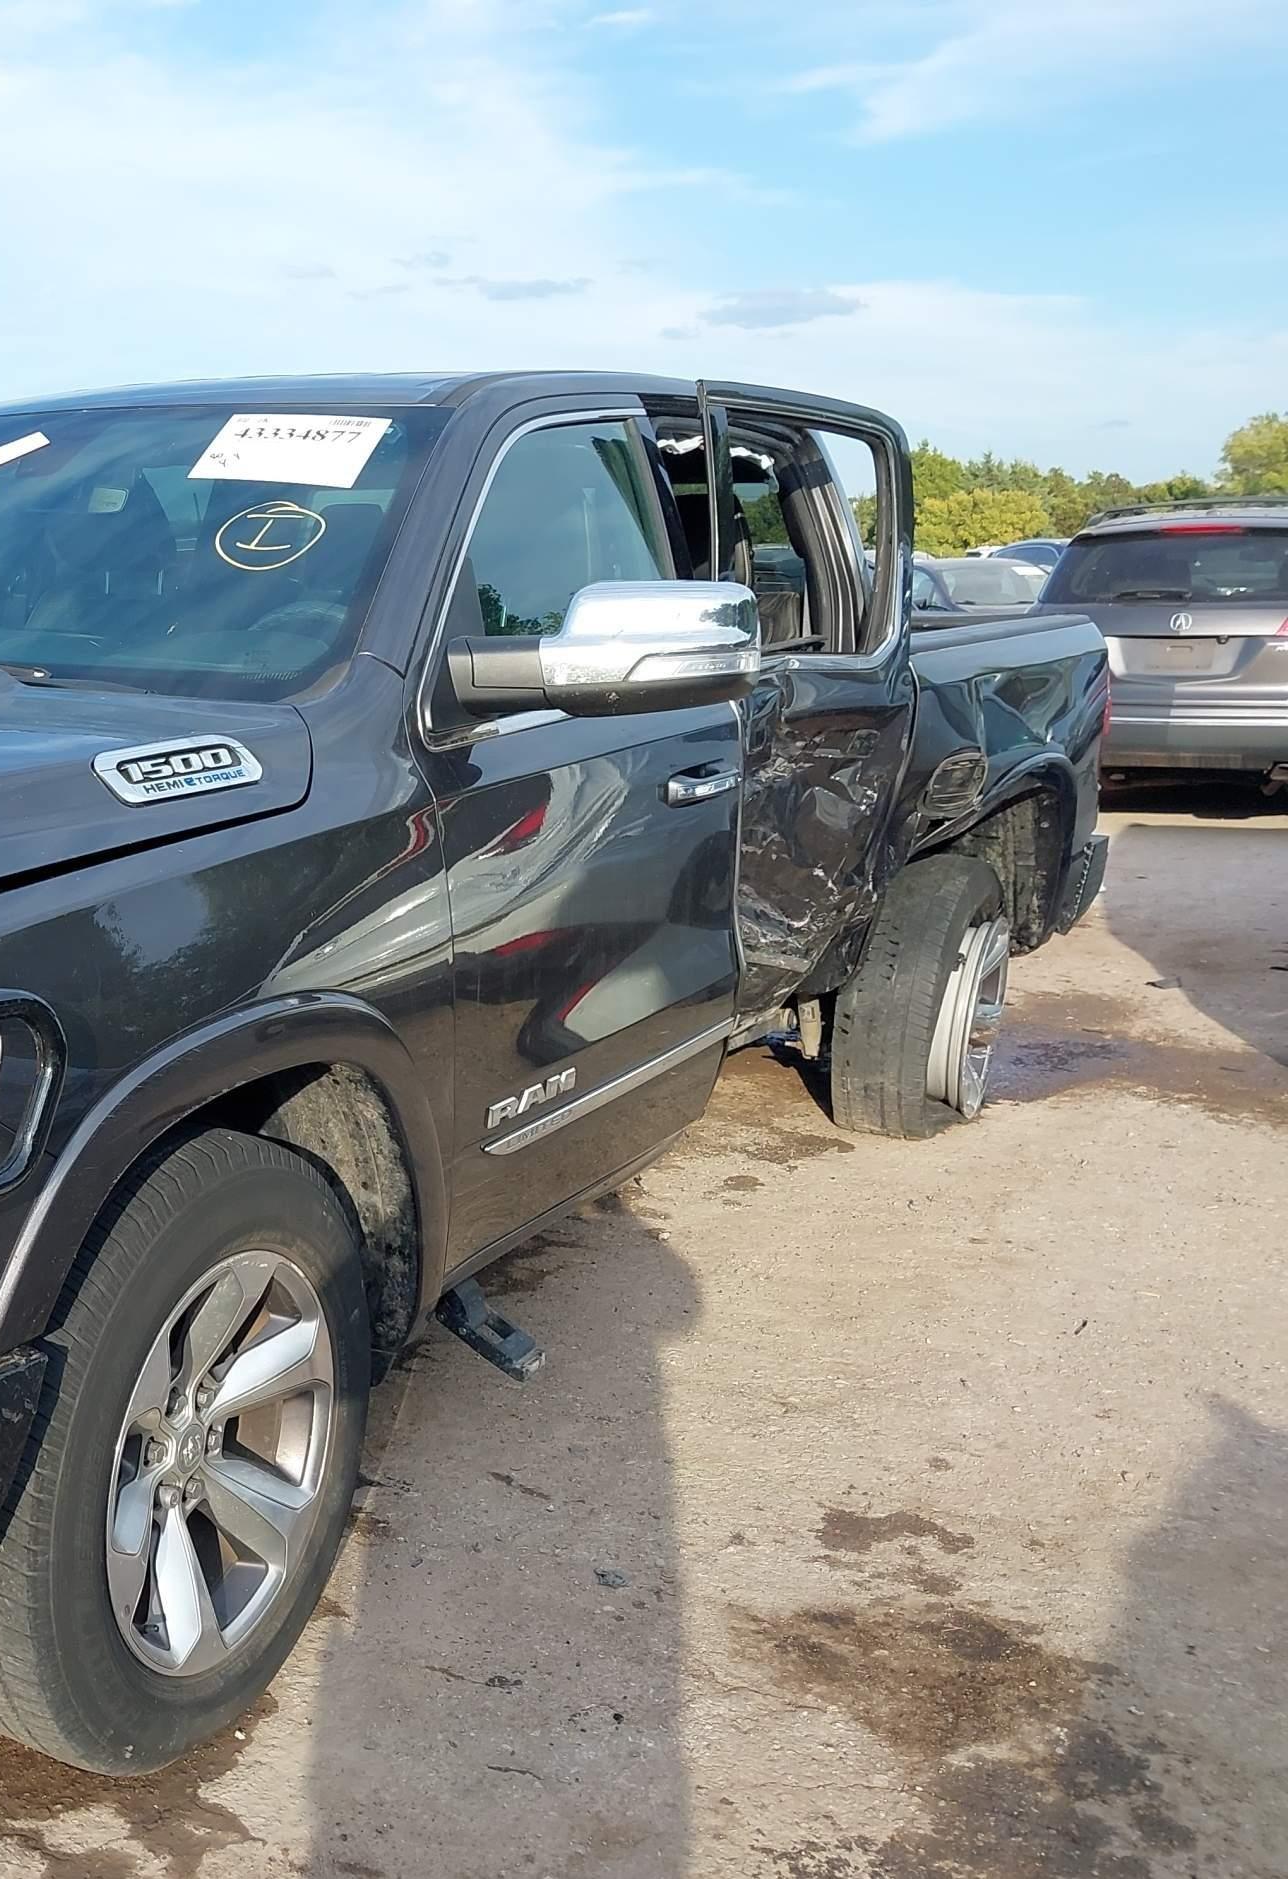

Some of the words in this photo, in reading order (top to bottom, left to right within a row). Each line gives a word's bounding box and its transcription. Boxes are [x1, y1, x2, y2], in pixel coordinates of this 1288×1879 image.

[234, 427, 362, 444] 43334877
[118, 748, 233, 783] 1500
[143, 779, 184, 794] HEMI
[485, 1066, 577, 1129] RAM
